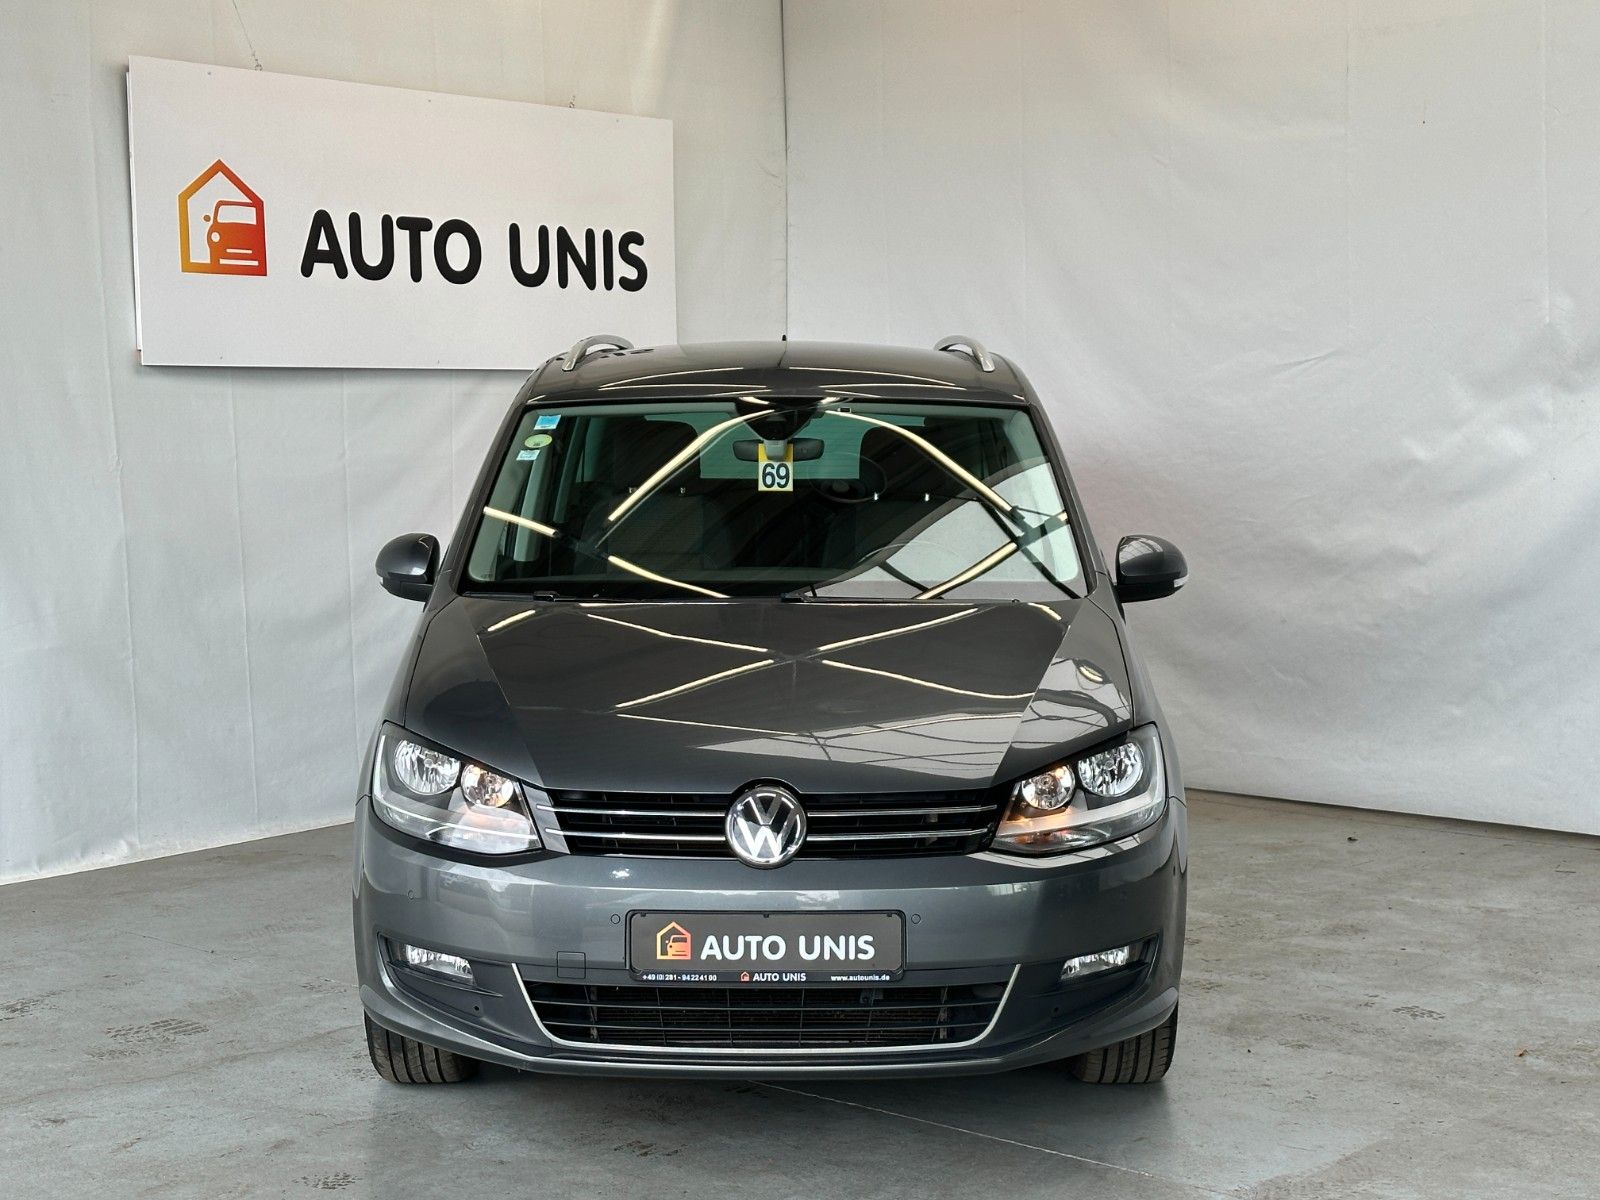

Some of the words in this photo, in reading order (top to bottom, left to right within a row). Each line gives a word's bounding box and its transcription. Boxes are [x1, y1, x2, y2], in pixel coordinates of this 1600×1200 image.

[300, 208, 482, 285] AUTO
[509, 222, 649, 292] UNIS
[762, 463, 790, 489] 69
[700, 935, 786, 961] AUTO
[798, 935, 876, 961] UNIS
[752, 973, 780, 982] AUTO
[782, 973, 807, 982] UNIS
